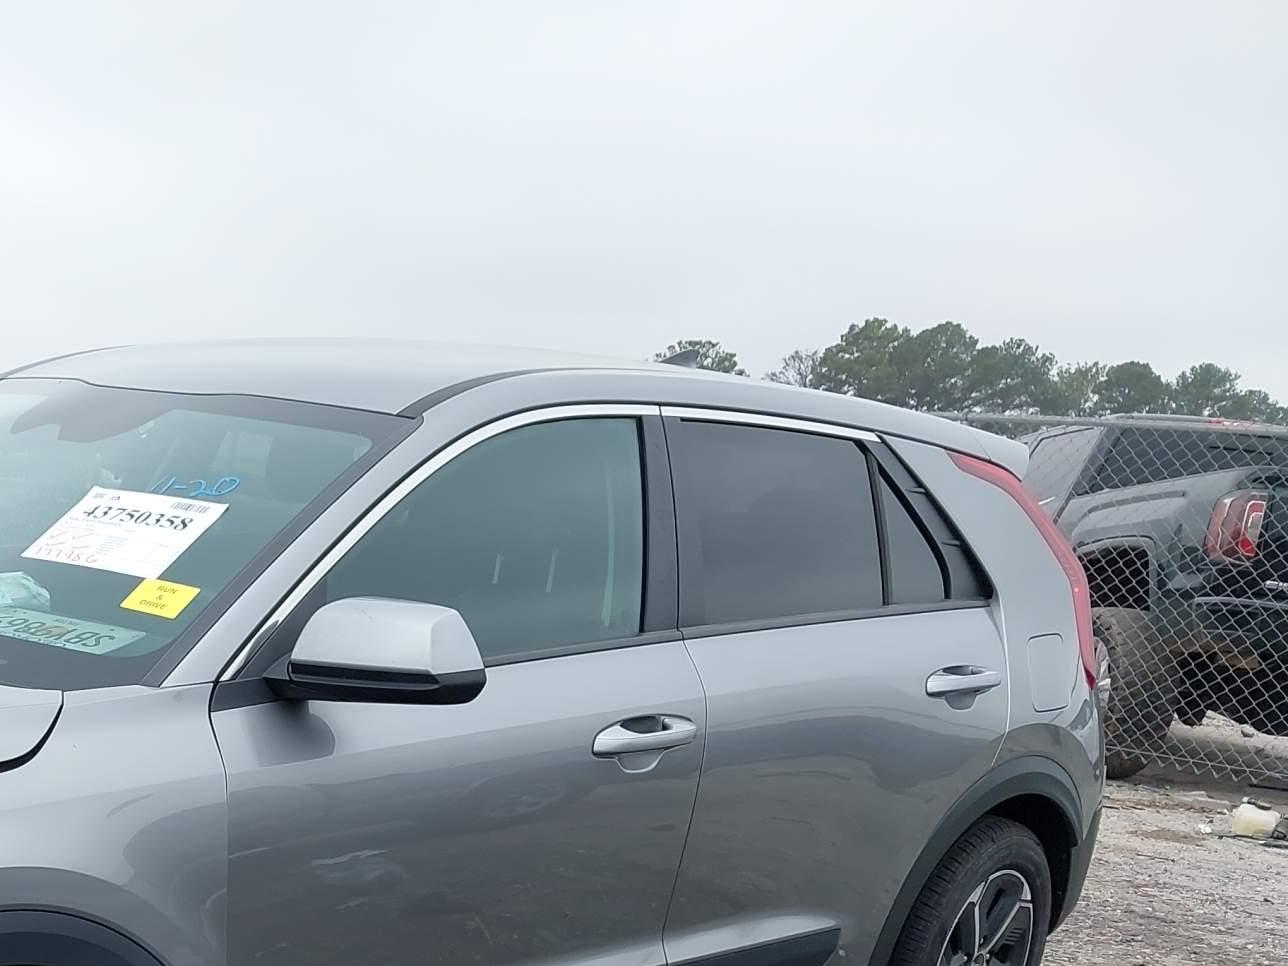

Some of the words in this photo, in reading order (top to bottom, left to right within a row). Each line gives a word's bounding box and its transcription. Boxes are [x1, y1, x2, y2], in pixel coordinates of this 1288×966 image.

[83, 504, 195, 531] 43750358
[157, 585, 178, 594] RUN
[139, 599, 168, 610] DRIVE
